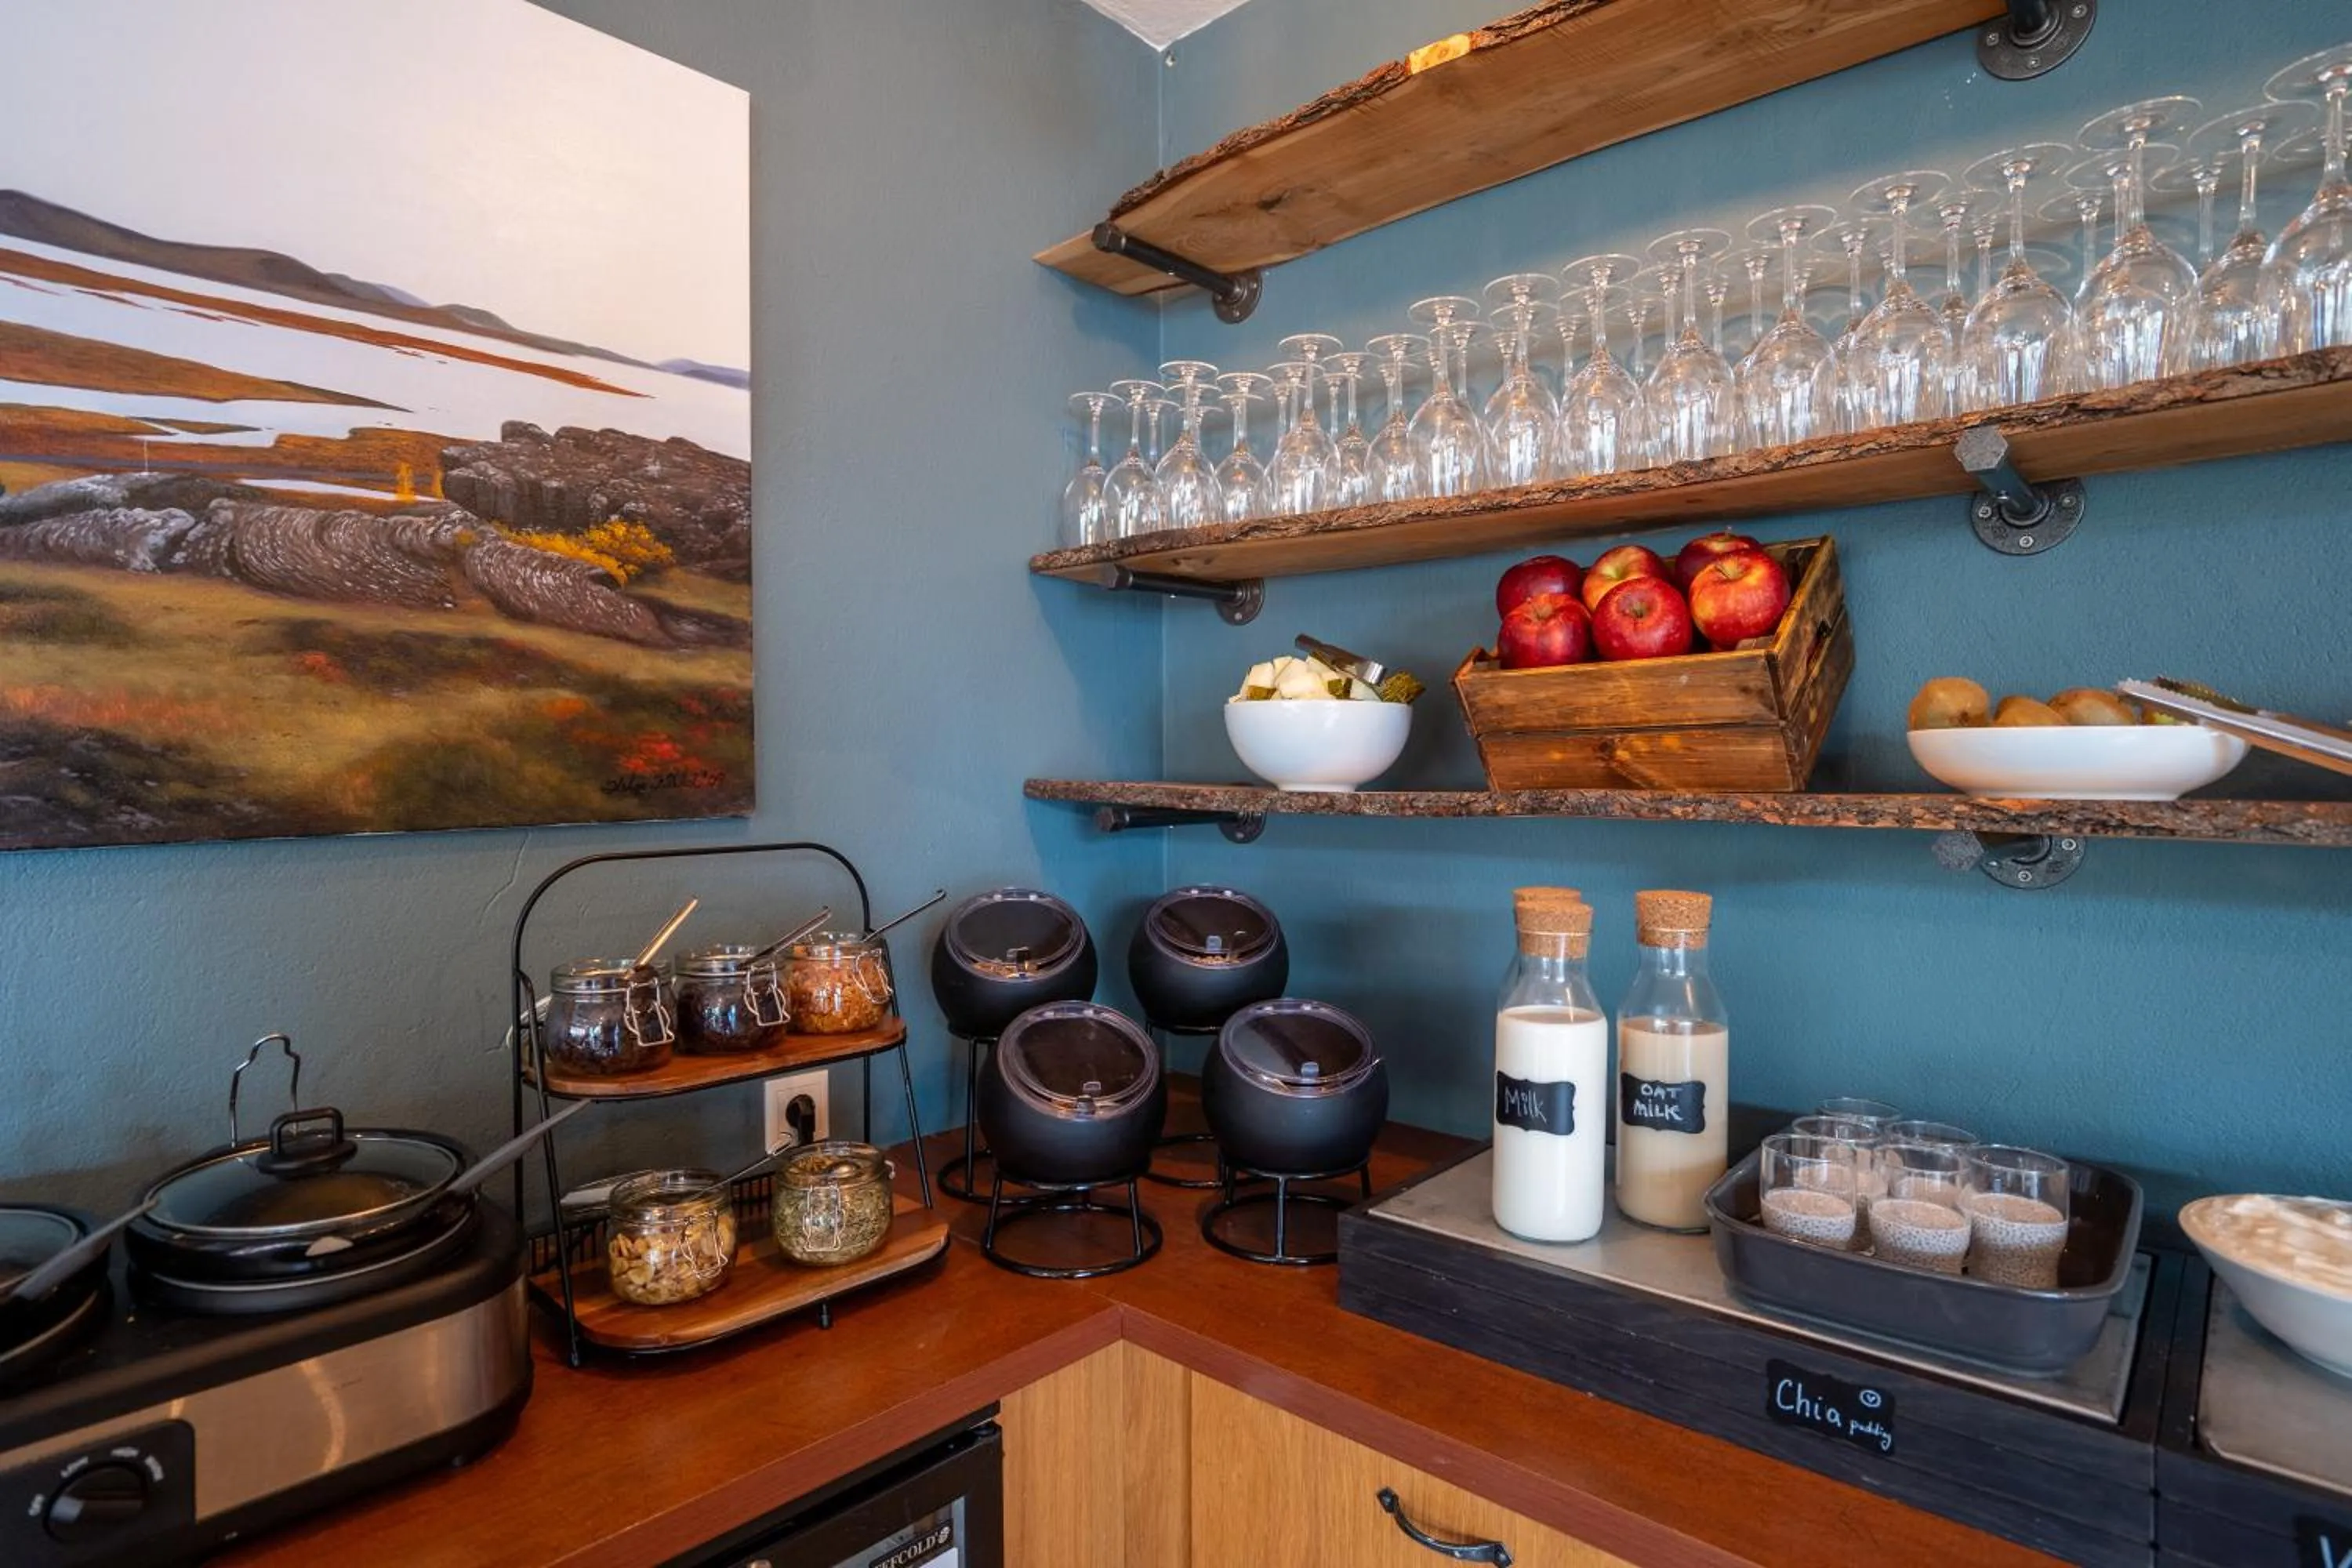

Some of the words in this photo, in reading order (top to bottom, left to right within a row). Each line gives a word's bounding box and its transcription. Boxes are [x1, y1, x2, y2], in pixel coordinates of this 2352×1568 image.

[1504, 1086, 1547, 1123] Milk
[1641, 1083, 1683, 1099] OAT
[1776, 1379, 1842, 1428] Chia
[874, 1535, 935, 1568] EFCOLD
